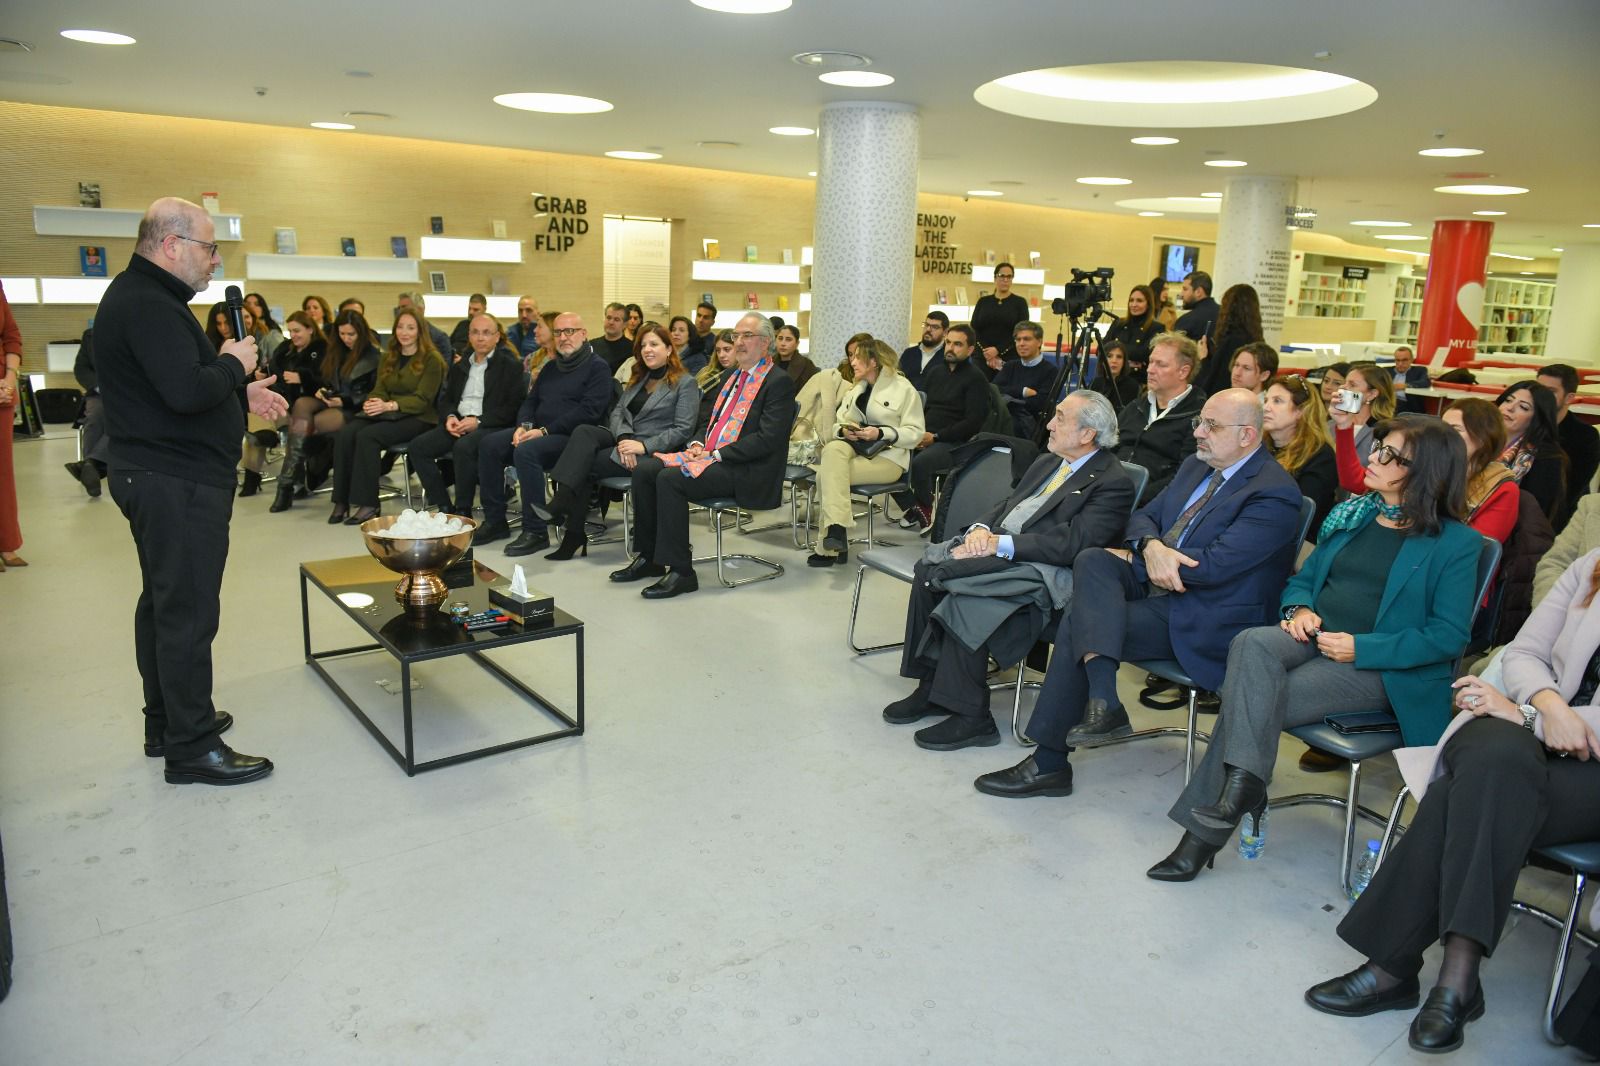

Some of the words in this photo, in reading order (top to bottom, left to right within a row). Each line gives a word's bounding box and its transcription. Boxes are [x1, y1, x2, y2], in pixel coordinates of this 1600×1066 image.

[534, 196, 587, 215] GRAB
[548, 216, 589, 235] AND
[917, 213, 956, 229] ENJOY
[535, 234, 574, 252] FLIP
[924, 230, 946, 244] THE
[915, 245, 957, 260] LATEST
[923, 260, 973, 275] UPDATES
[1450, 339, 1465, 348] MY
